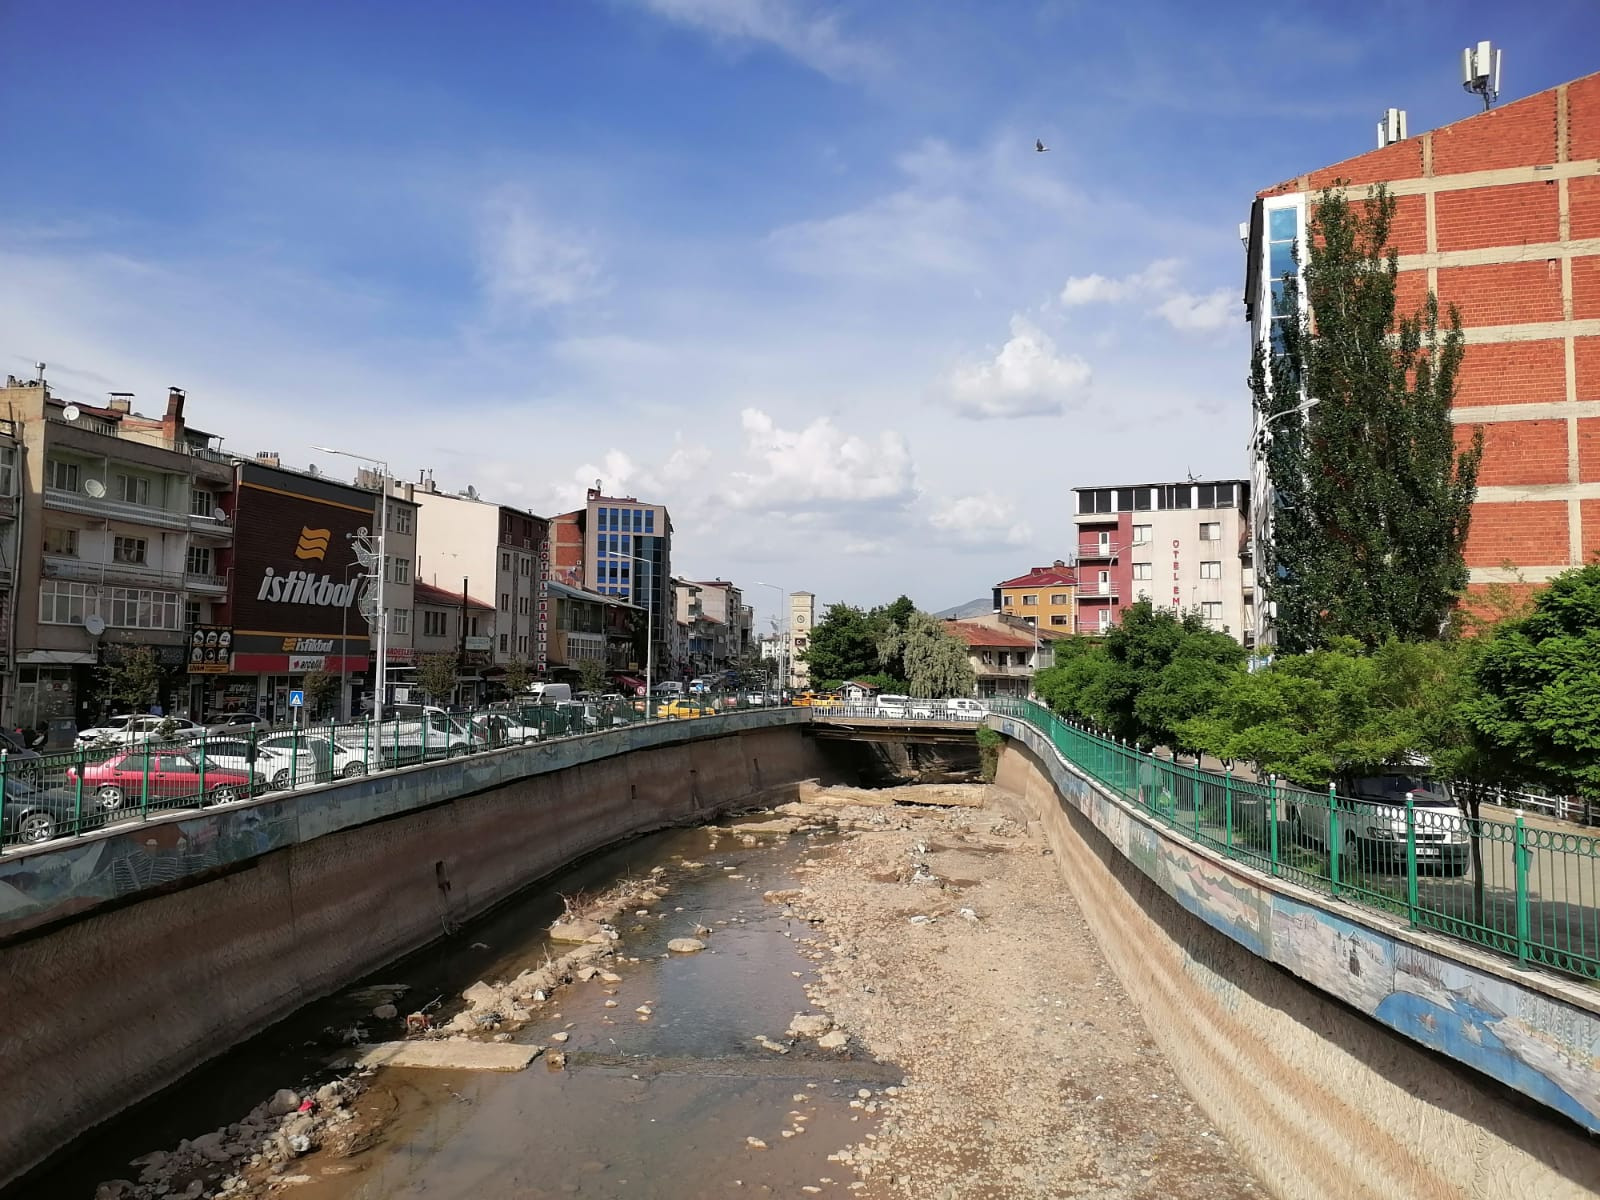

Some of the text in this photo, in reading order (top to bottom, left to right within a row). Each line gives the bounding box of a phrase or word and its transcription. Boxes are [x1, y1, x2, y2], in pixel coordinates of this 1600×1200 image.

[257, 567, 359, 608] istikbal
[538, 541, 549, 672] HOTEL BALLICA
